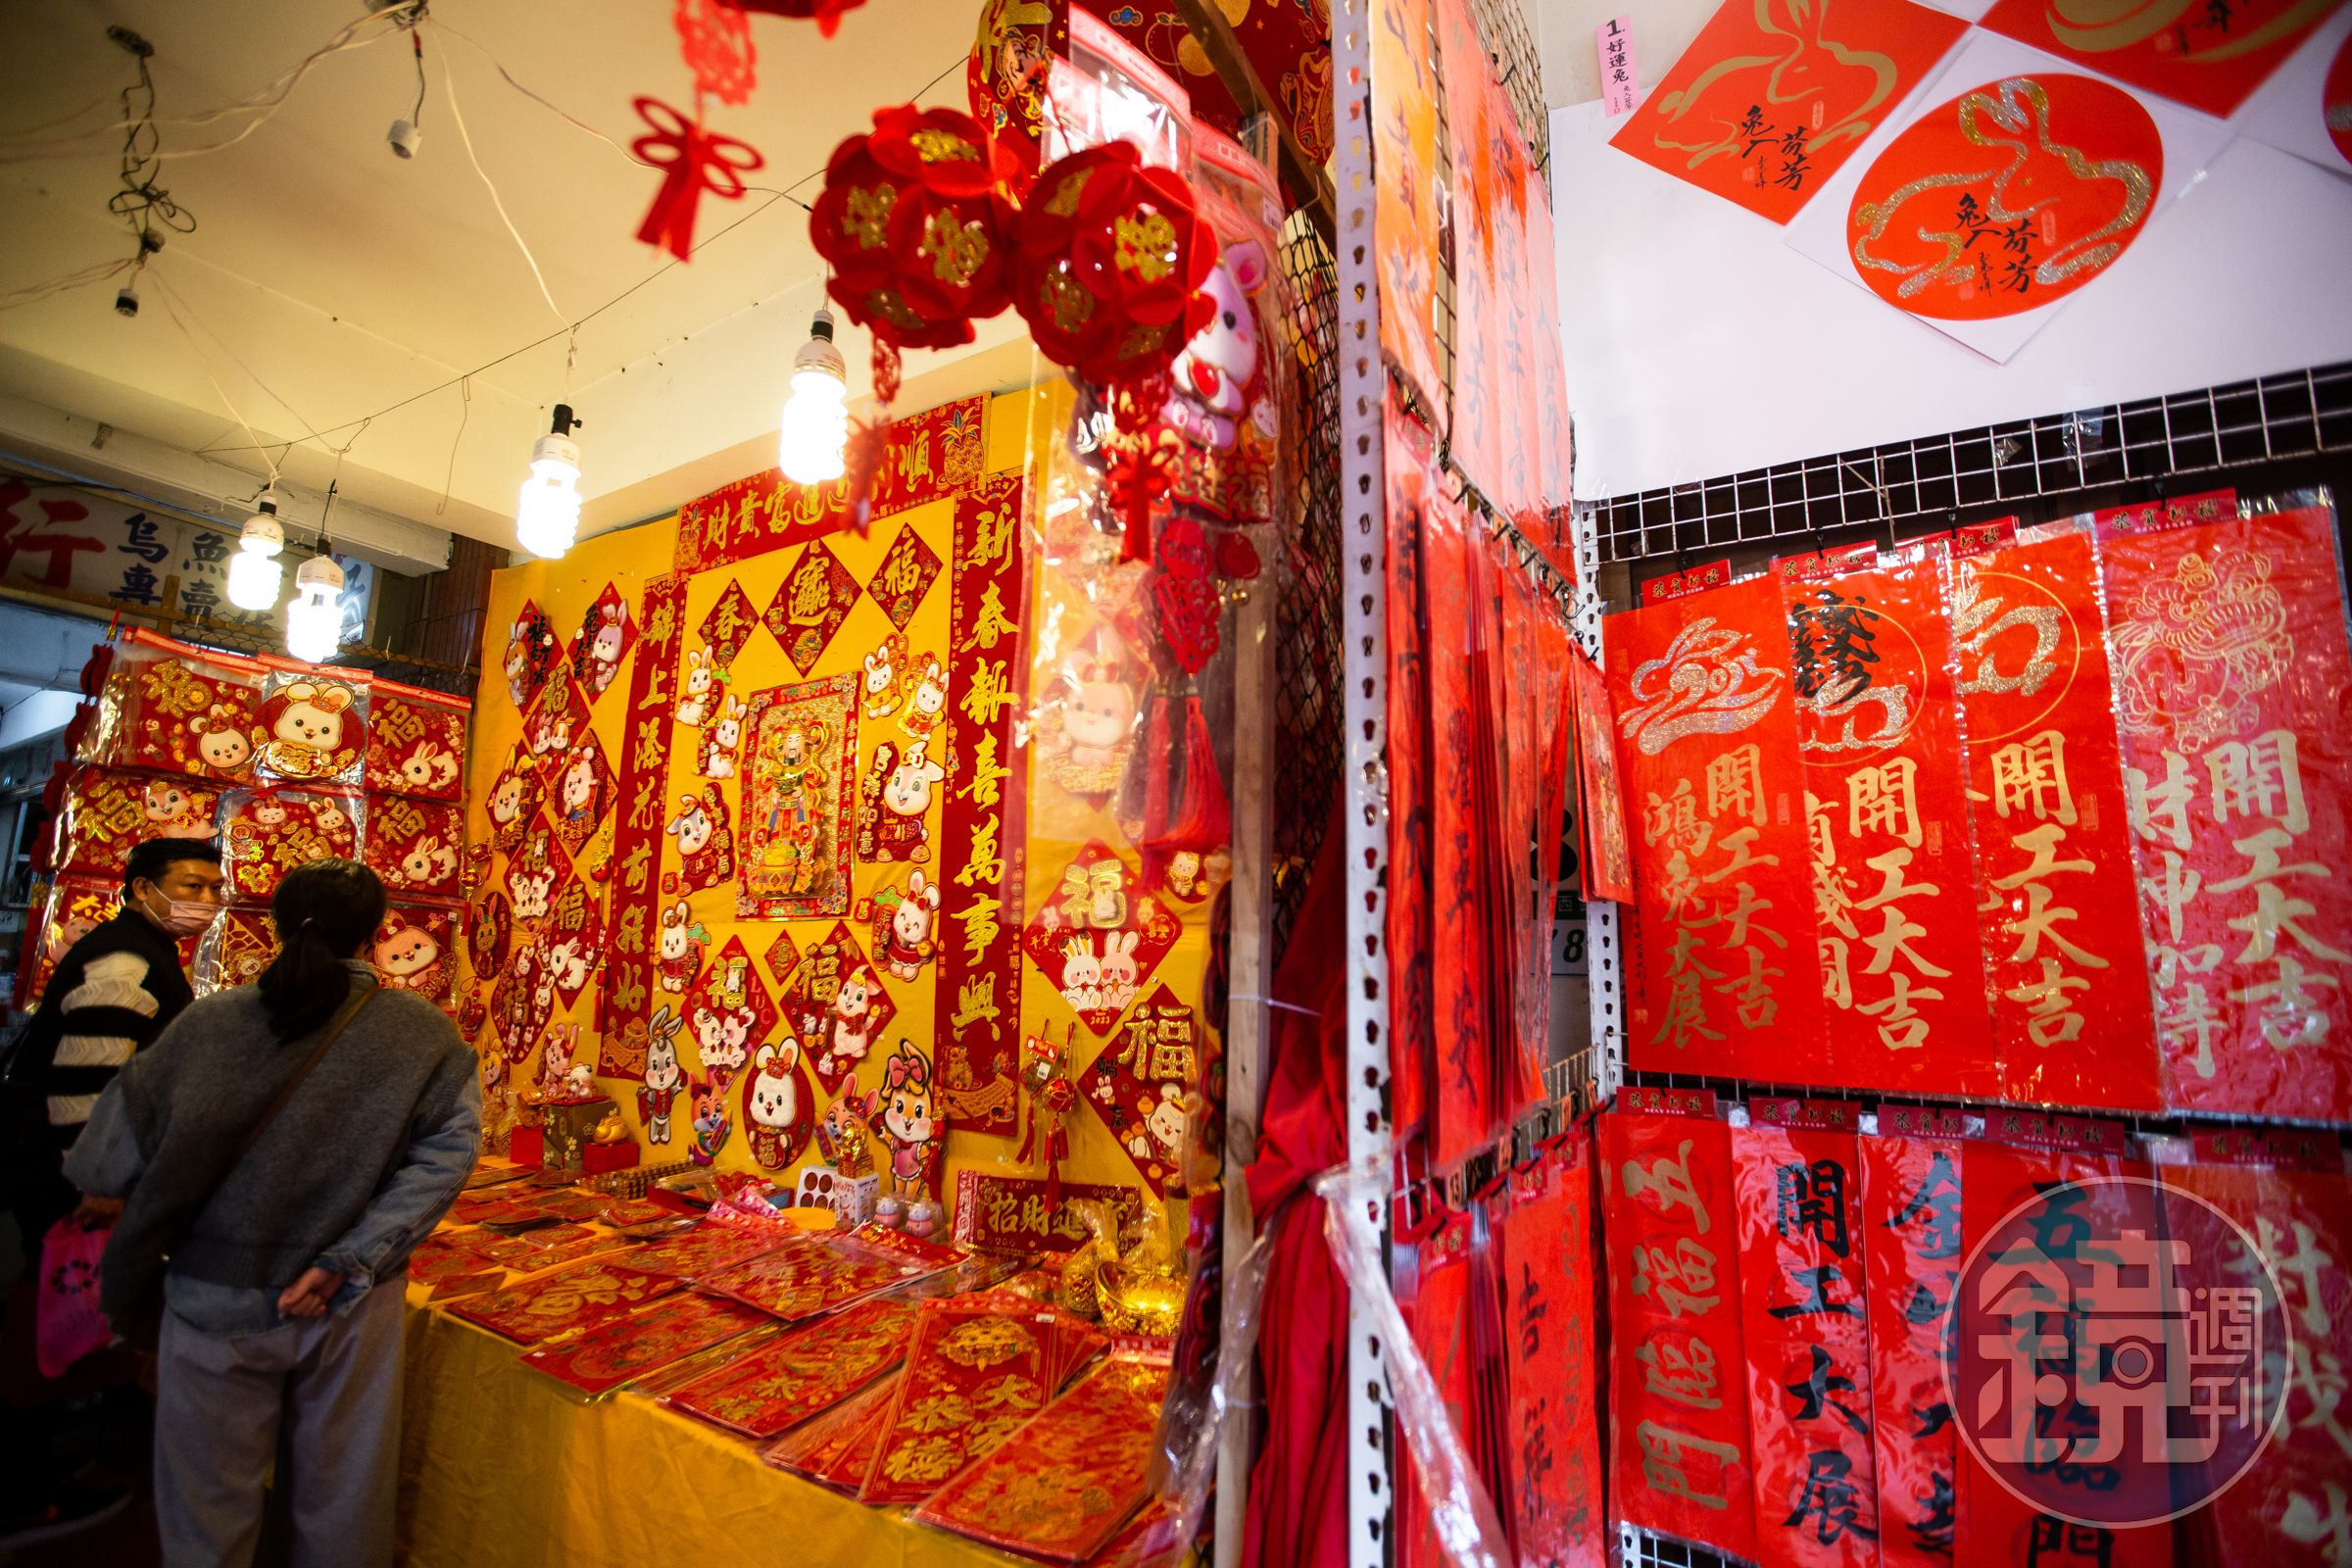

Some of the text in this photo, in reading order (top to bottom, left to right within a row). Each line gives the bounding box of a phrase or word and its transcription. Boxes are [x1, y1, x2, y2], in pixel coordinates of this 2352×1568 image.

[884, 539, 922, 597] 福
[713, 593, 744, 642] 春
[141, 657, 213, 719] 福
[370, 698, 426, 750] 福
[368, 795, 427, 845] 福
[555, 878, 586, 931] 福
[1060, 858, 1126, 929] 福
[1846, 756, 1953, 1052] 開工大吉
[1990, 729, 2110, 1049] 開工大吉
[2203, 729, 2352, 1051] 開工大吉
[797, 943, 841, 1004] 福
[1117, 1002, 1199, 1082] 福
[1765, 1158, 1878, 1546] 開工大展
